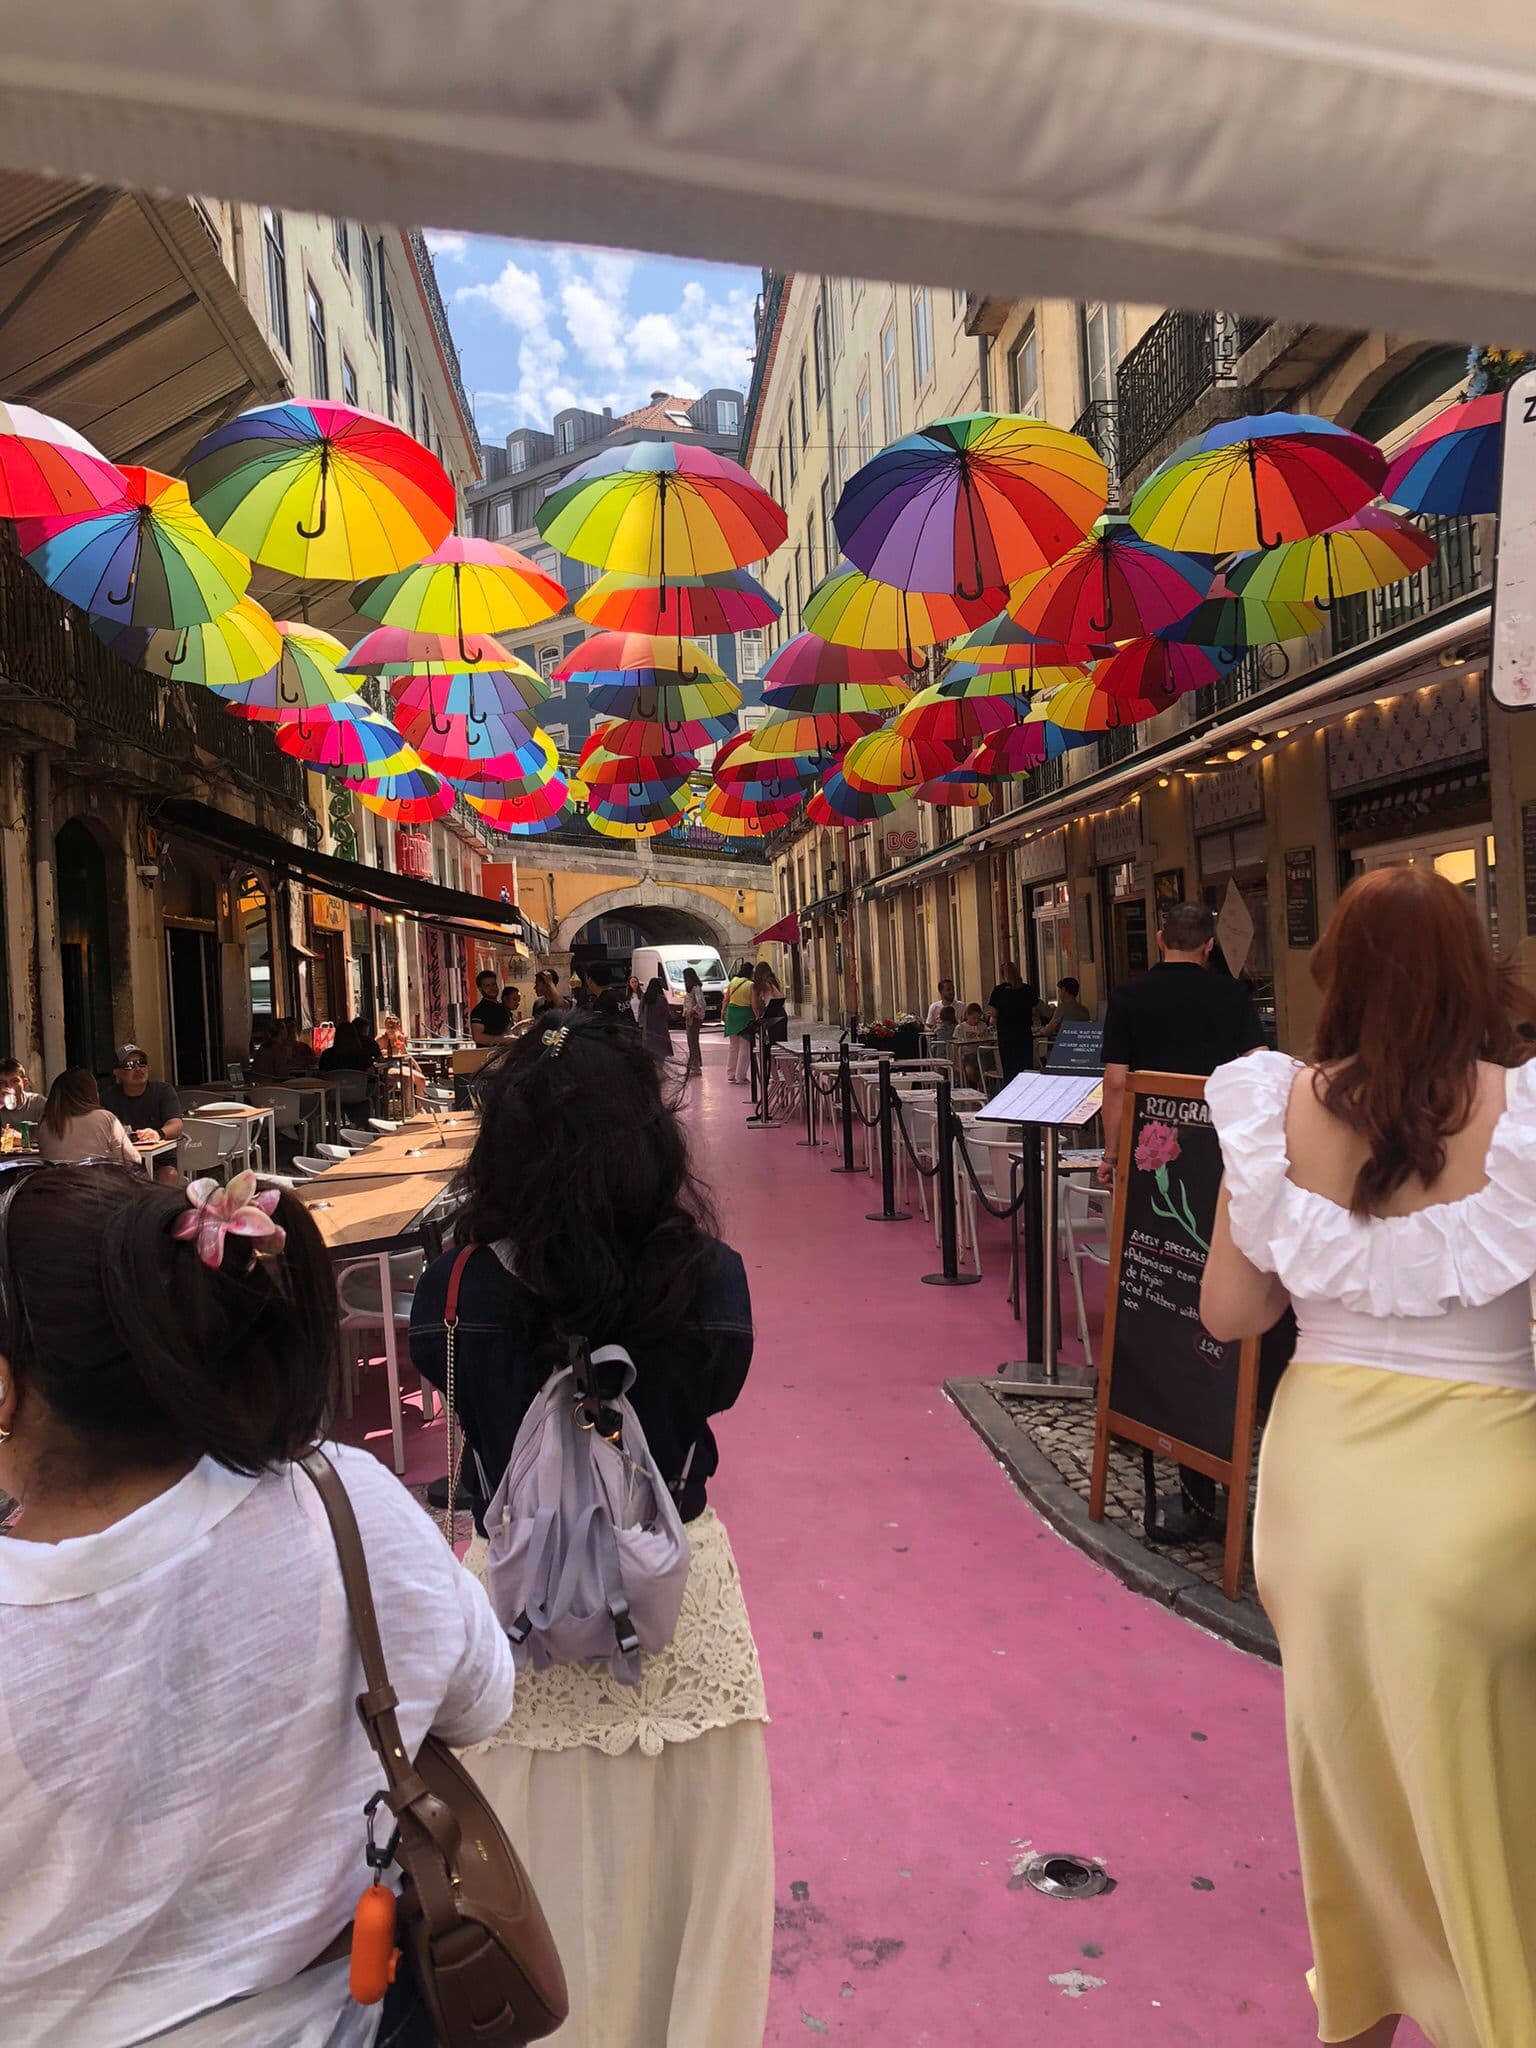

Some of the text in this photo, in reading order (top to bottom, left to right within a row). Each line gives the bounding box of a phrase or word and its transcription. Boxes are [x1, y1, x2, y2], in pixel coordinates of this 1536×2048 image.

[1146, 1097, 1212, 1123] RIO GRA
[1130, 1229, 1206, 1263] DAILY SPECIALS
[1126, 1281, 1143, 1296] Cod
